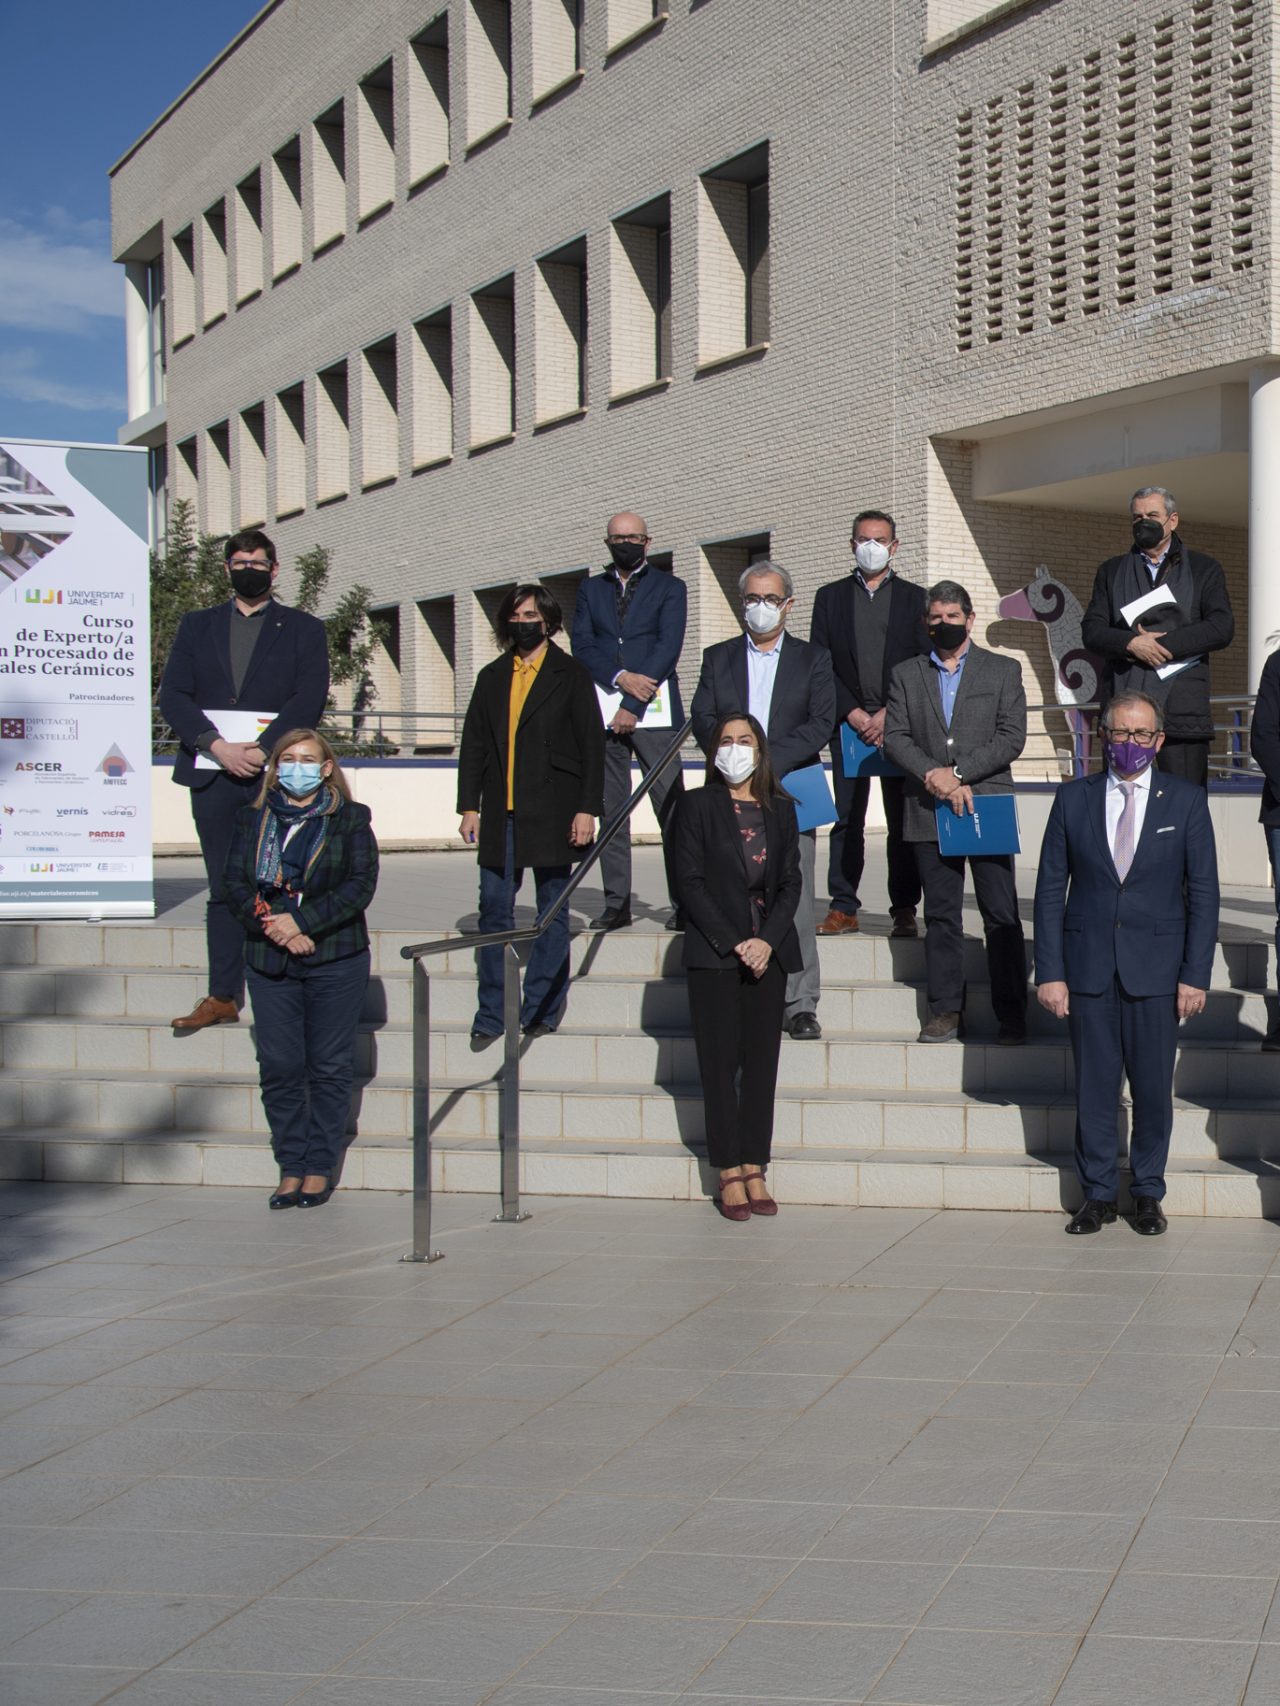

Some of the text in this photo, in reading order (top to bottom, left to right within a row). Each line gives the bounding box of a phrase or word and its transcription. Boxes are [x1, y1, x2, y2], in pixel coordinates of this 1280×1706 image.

[25, 588, 63, 605] UJI
[67, 590, 125, 599] UNIVERSITAT
[67, 598, 98, 606] JAUME
[83, 614, 134, 629] Curso
[16, 628, 134, 648] de Experto/a
[14, 644, 108, 661] Procesado
[113, 646, 135, 661] de
[41, 662, 135, 678] Cerámicos
[69, 693, 135, 702] Patrocinadores
[15, 762, 62, 772] ASCER
[89, 830, 125, 838] PAMESA
